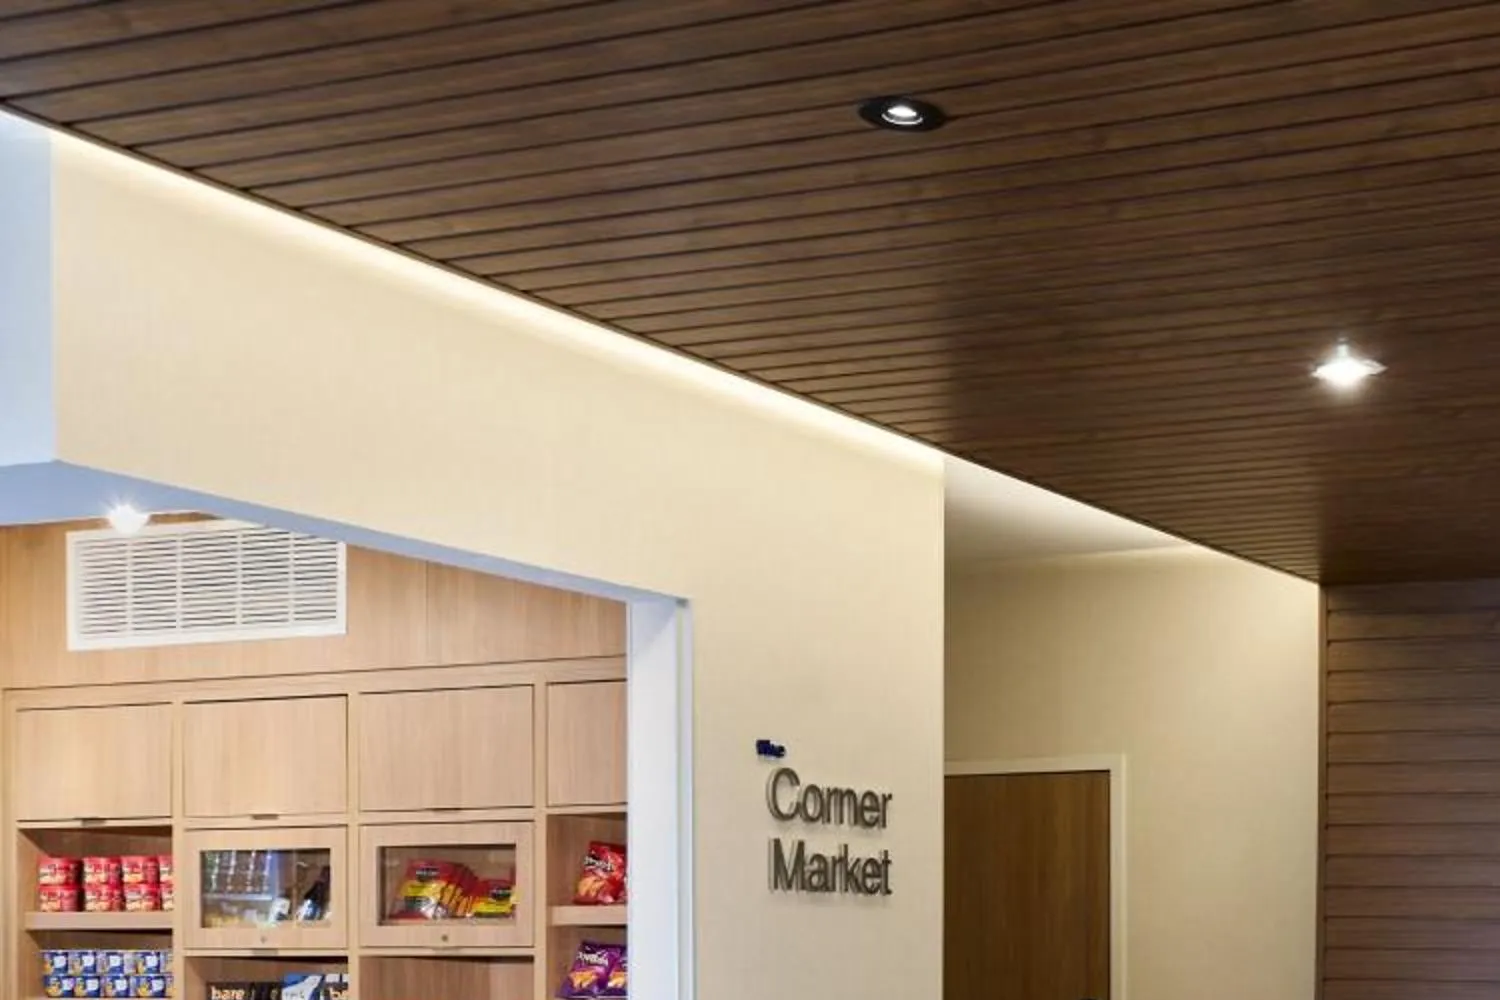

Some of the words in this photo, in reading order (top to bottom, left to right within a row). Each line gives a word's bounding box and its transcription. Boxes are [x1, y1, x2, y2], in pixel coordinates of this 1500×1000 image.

[767, 767, 893, 829] Corner
[769, 838, 893, 896] Market
[210, 985, 246, 1000] bare
